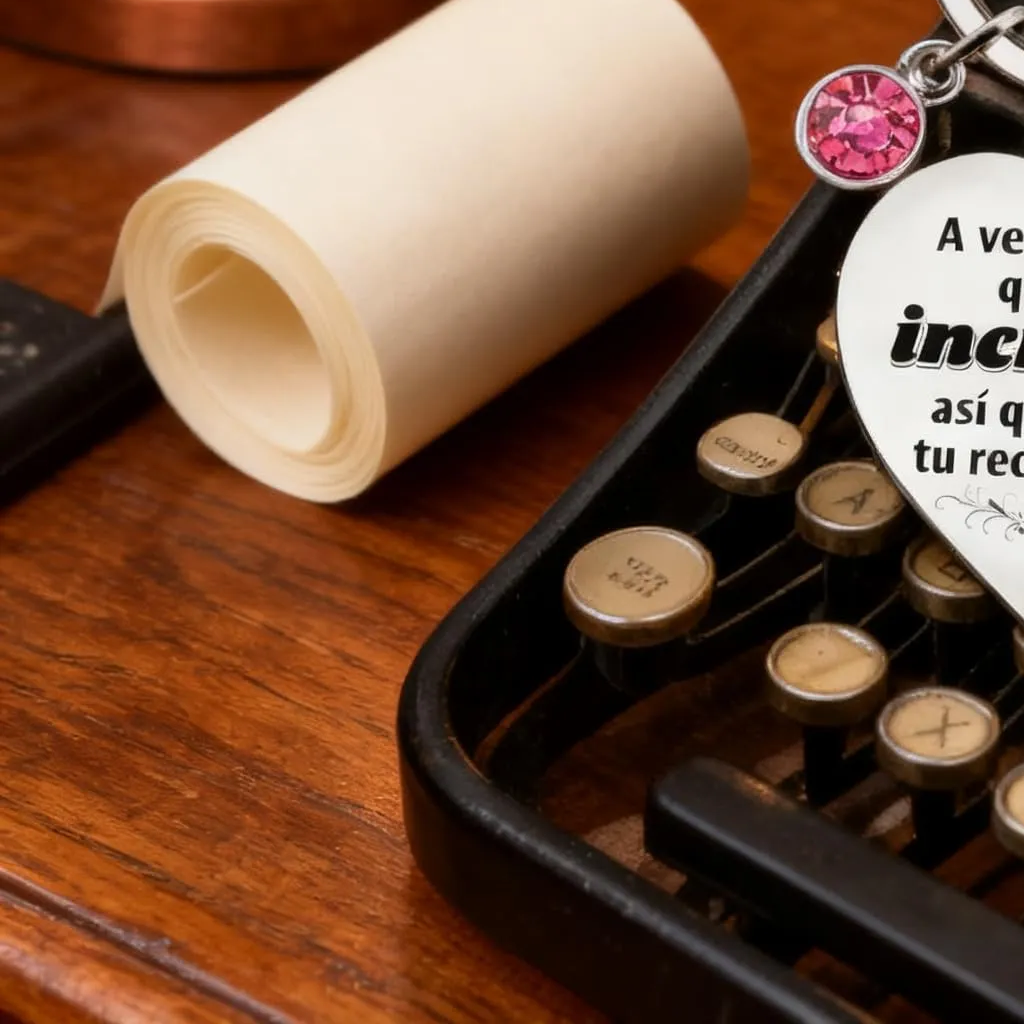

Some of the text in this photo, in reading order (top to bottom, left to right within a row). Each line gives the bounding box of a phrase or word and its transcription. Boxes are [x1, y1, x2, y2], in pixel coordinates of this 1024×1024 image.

[937, 217, 964, 252] A
[932, 389, 988, 425] así
[914, 440, 954, 473] tu
[912, 705, 970, 749] X
